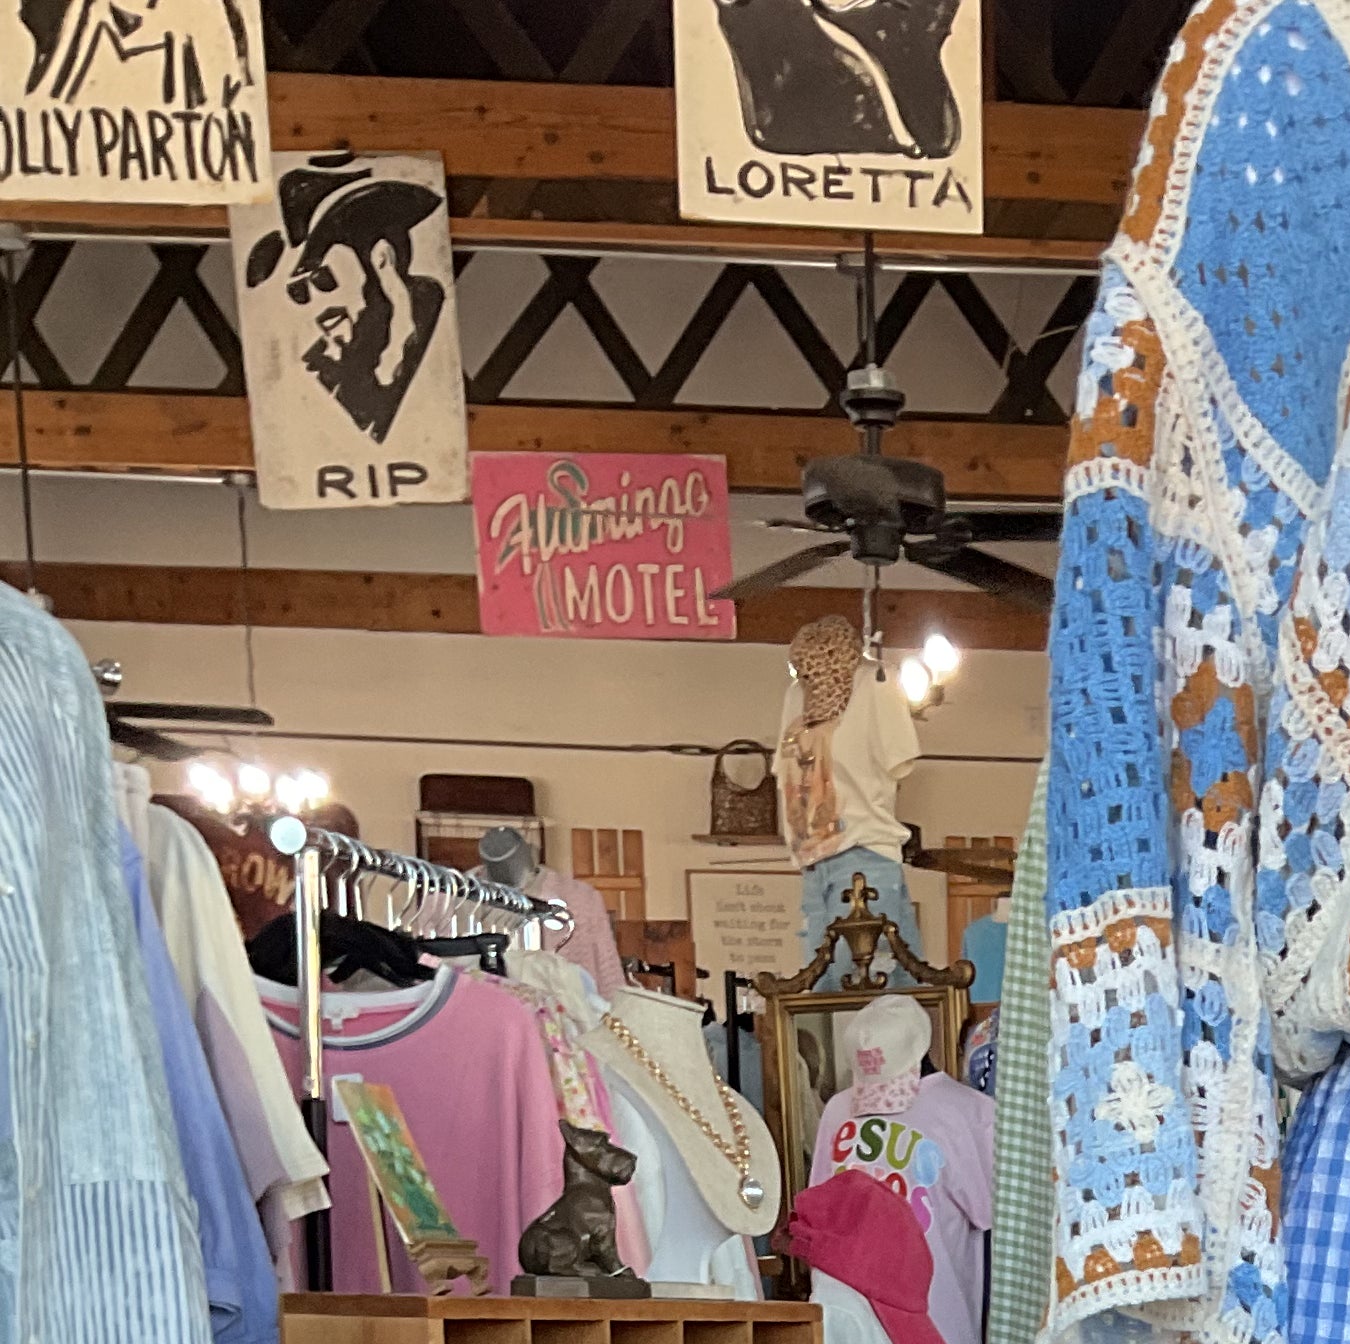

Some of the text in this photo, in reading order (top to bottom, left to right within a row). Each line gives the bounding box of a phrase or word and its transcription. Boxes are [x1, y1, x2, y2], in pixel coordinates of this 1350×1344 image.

[89, 106, 258, 183] PARTON
[705, 156, 973, 214] LORETTA
[316, 461, 429, 499] RIP
[489, 470, 711, 575] Flamingo
[564, 563, 719, 626] MOTEL
